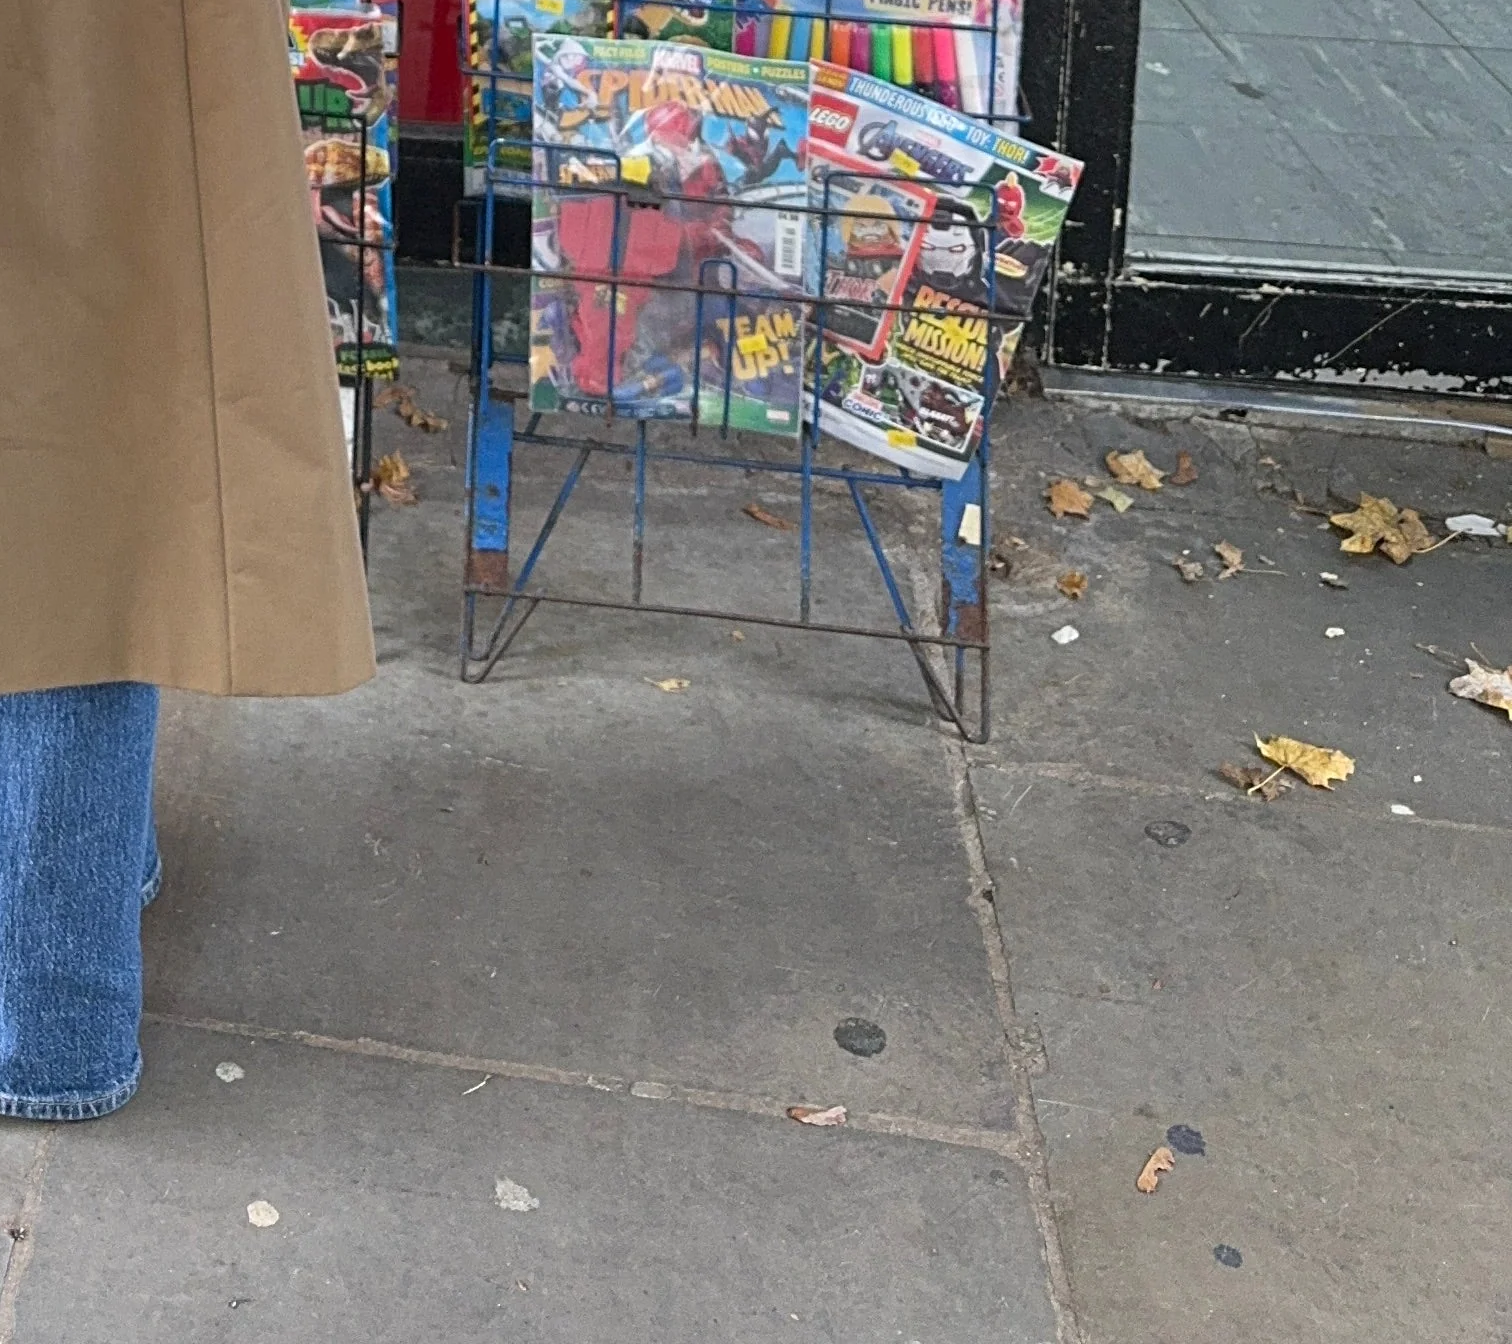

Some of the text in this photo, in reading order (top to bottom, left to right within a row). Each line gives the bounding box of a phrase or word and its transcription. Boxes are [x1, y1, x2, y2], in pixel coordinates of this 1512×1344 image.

[761, 65, 807, 81] PUZZLES
[809, 104, 852, 133] LEGO
[848, 75, 1031, 165] THUNDEROUS THOR!
[716, 310, 797, 342] TEAM
[733, 342, 794, 381] UP!
[842, 397, 883, 421] COMIC
